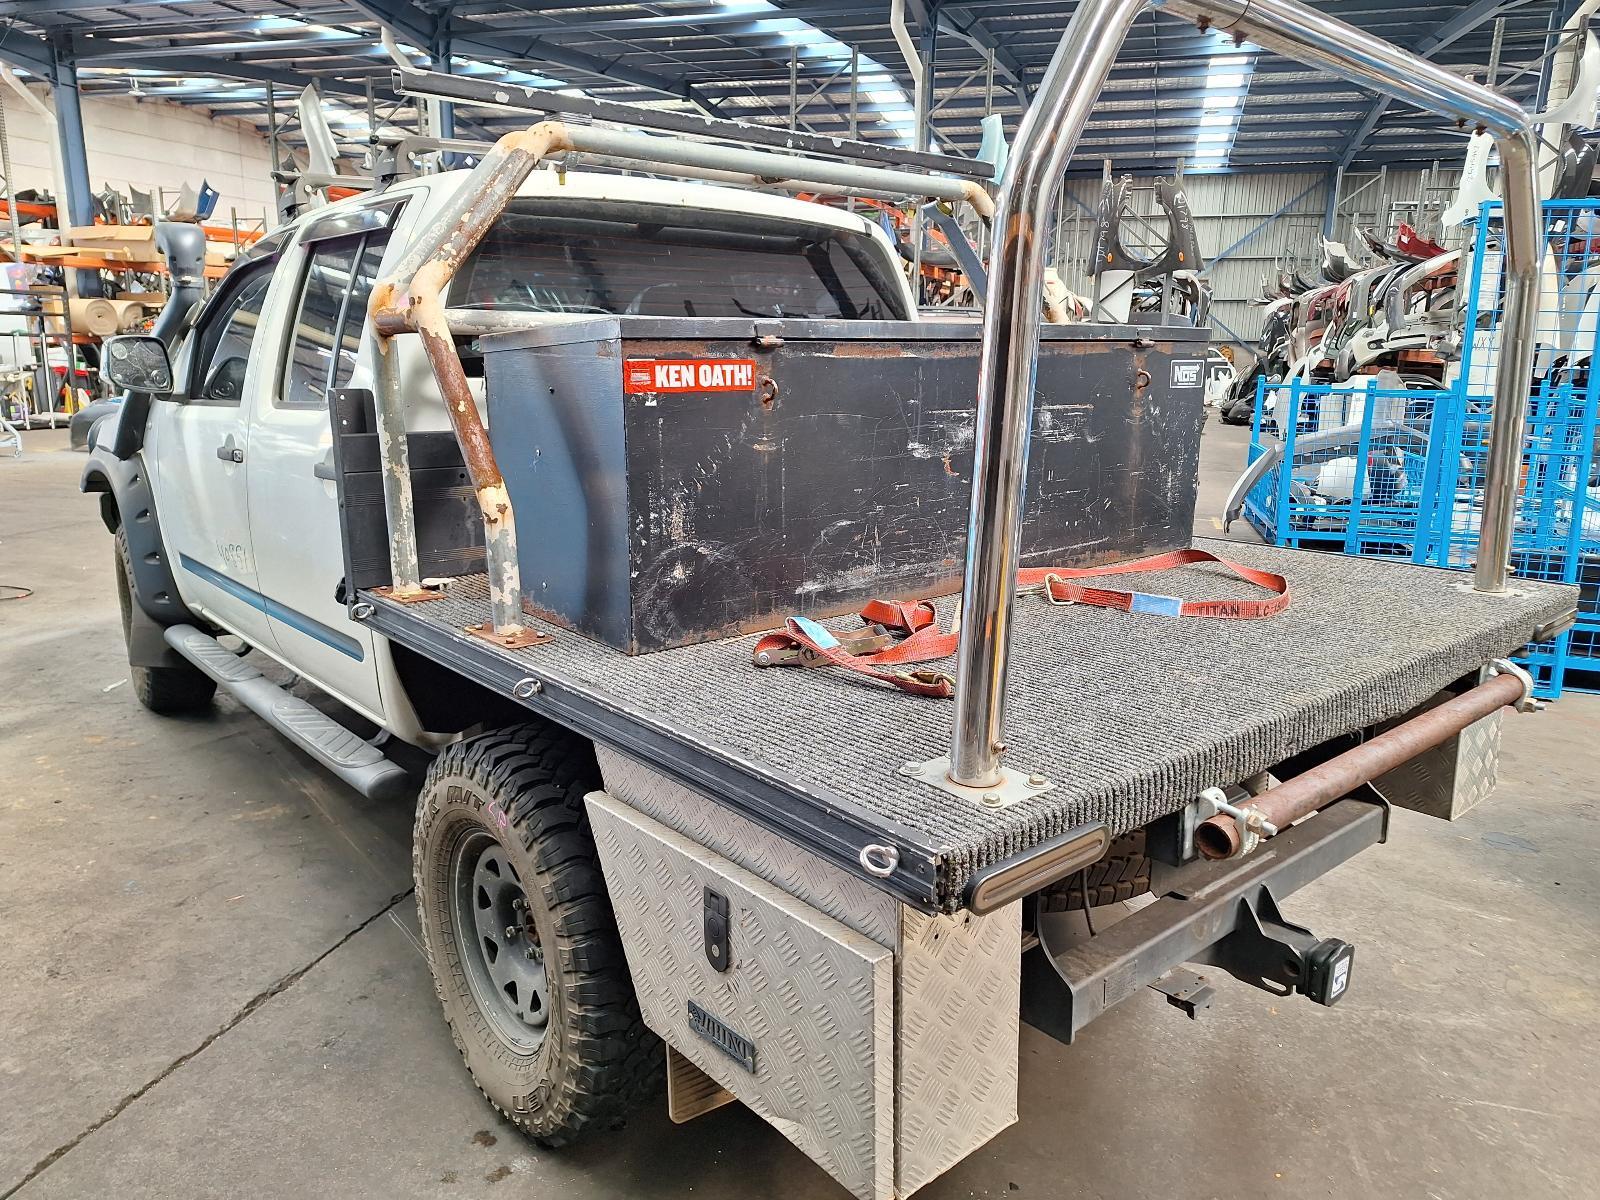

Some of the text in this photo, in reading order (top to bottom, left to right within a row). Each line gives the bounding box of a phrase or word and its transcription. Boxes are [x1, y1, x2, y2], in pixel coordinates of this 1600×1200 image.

[655, 364, 696, 388] KEN
[698, 364, 752, 388] OATH!
[1196, 604, 1240, 617] TITAN
